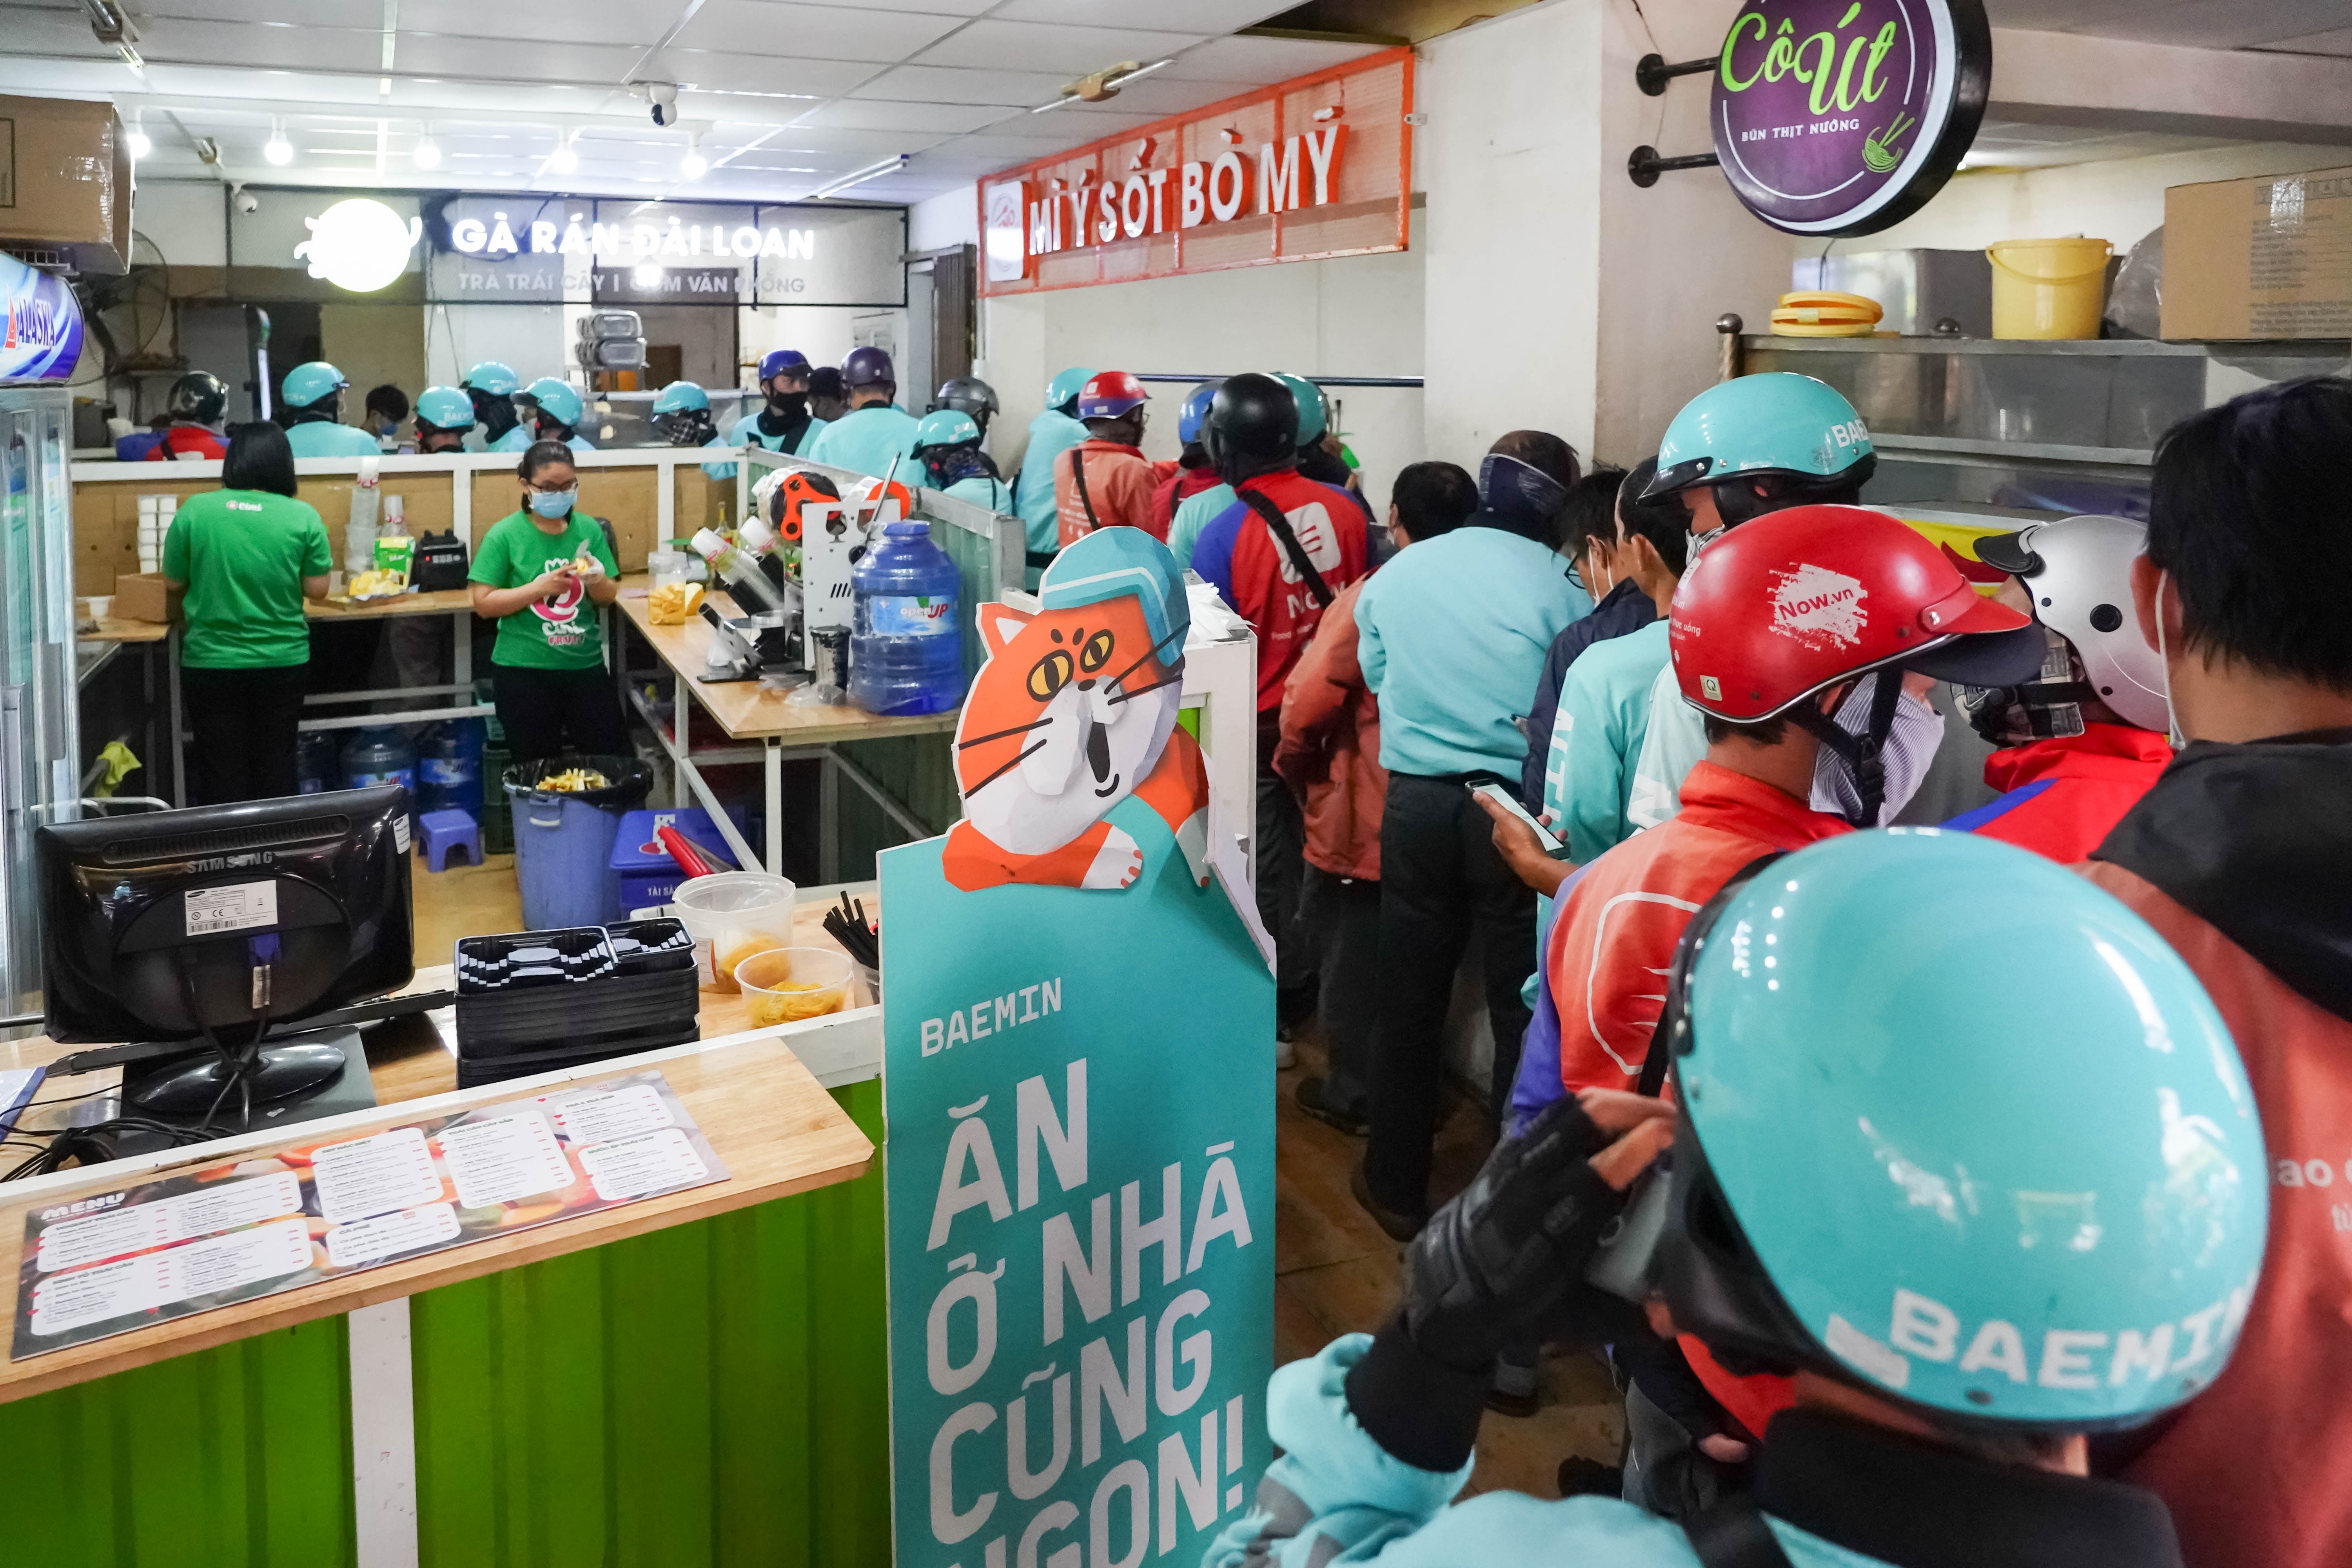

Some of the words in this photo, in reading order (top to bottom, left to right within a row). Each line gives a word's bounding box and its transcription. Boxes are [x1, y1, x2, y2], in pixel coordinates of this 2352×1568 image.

[1721, 12, 1795, 92] Cô
[1794, 2, 1896, 115] Út
[1742, 128, 1766, 142] BÚN
[1772, 124, 1804, 138] THỊT
[452, 211, 519, 253] GÀ
[532, 212, 619, 255] RÁN
[632, 216, 701, 257] ĐÀI
[713, 226, 814, 260] LOAN
[1029, 178, 1065, 256] MÌ
[1071, 169, 1095, 248] Ý
[1099, 138, 1171, 243] SỐT
[1181, 128, 1247, 229] BÒ
[688, 272, 728, 292] VĂN
[186, 851, 273, 874] SAMSUNG
[921, 976, 1062, 1058] BAEMIN
[926, 1057, 1088, 1252] ĂN
[40, 1192, 125, 1220] MENU
[926, 1252, 1006, 1396] Ở
[929, 1289, 1212, 1545] CŨNG
[943, 1394, 1243, 1568] GON!
